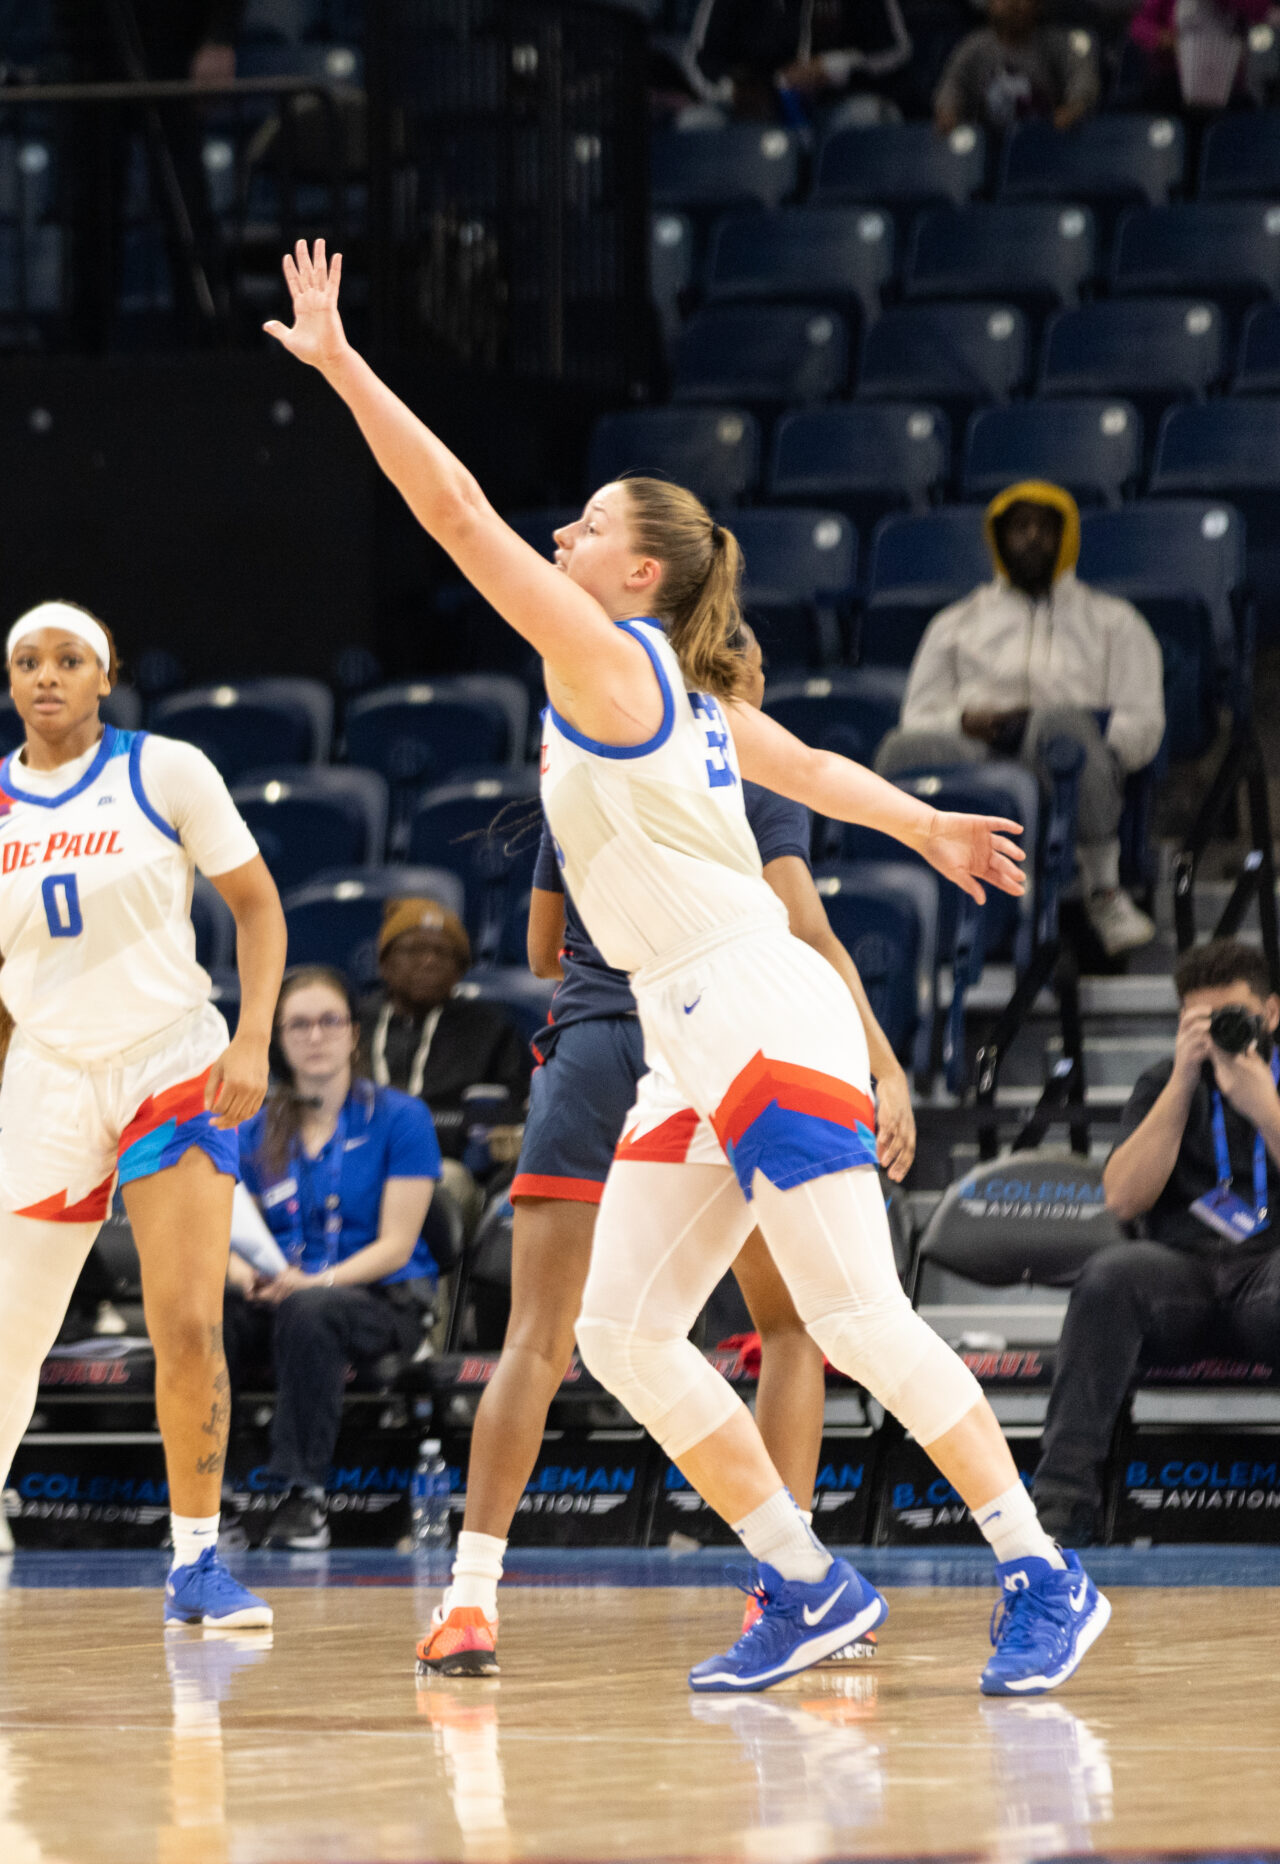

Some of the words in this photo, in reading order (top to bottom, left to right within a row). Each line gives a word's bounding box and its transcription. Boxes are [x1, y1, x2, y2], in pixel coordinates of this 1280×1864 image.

[41, 873, 83, 938] 0
[987, 1201, 1080, 1220] AVIATION
[1125, 1461, 1280, 1488] B.COLEM
[516, 1494, 592, 1515] ATION
[1163, 1489, 1280, 1510] AVIATION
[23, 1500, 138, 1523] AVIATION
